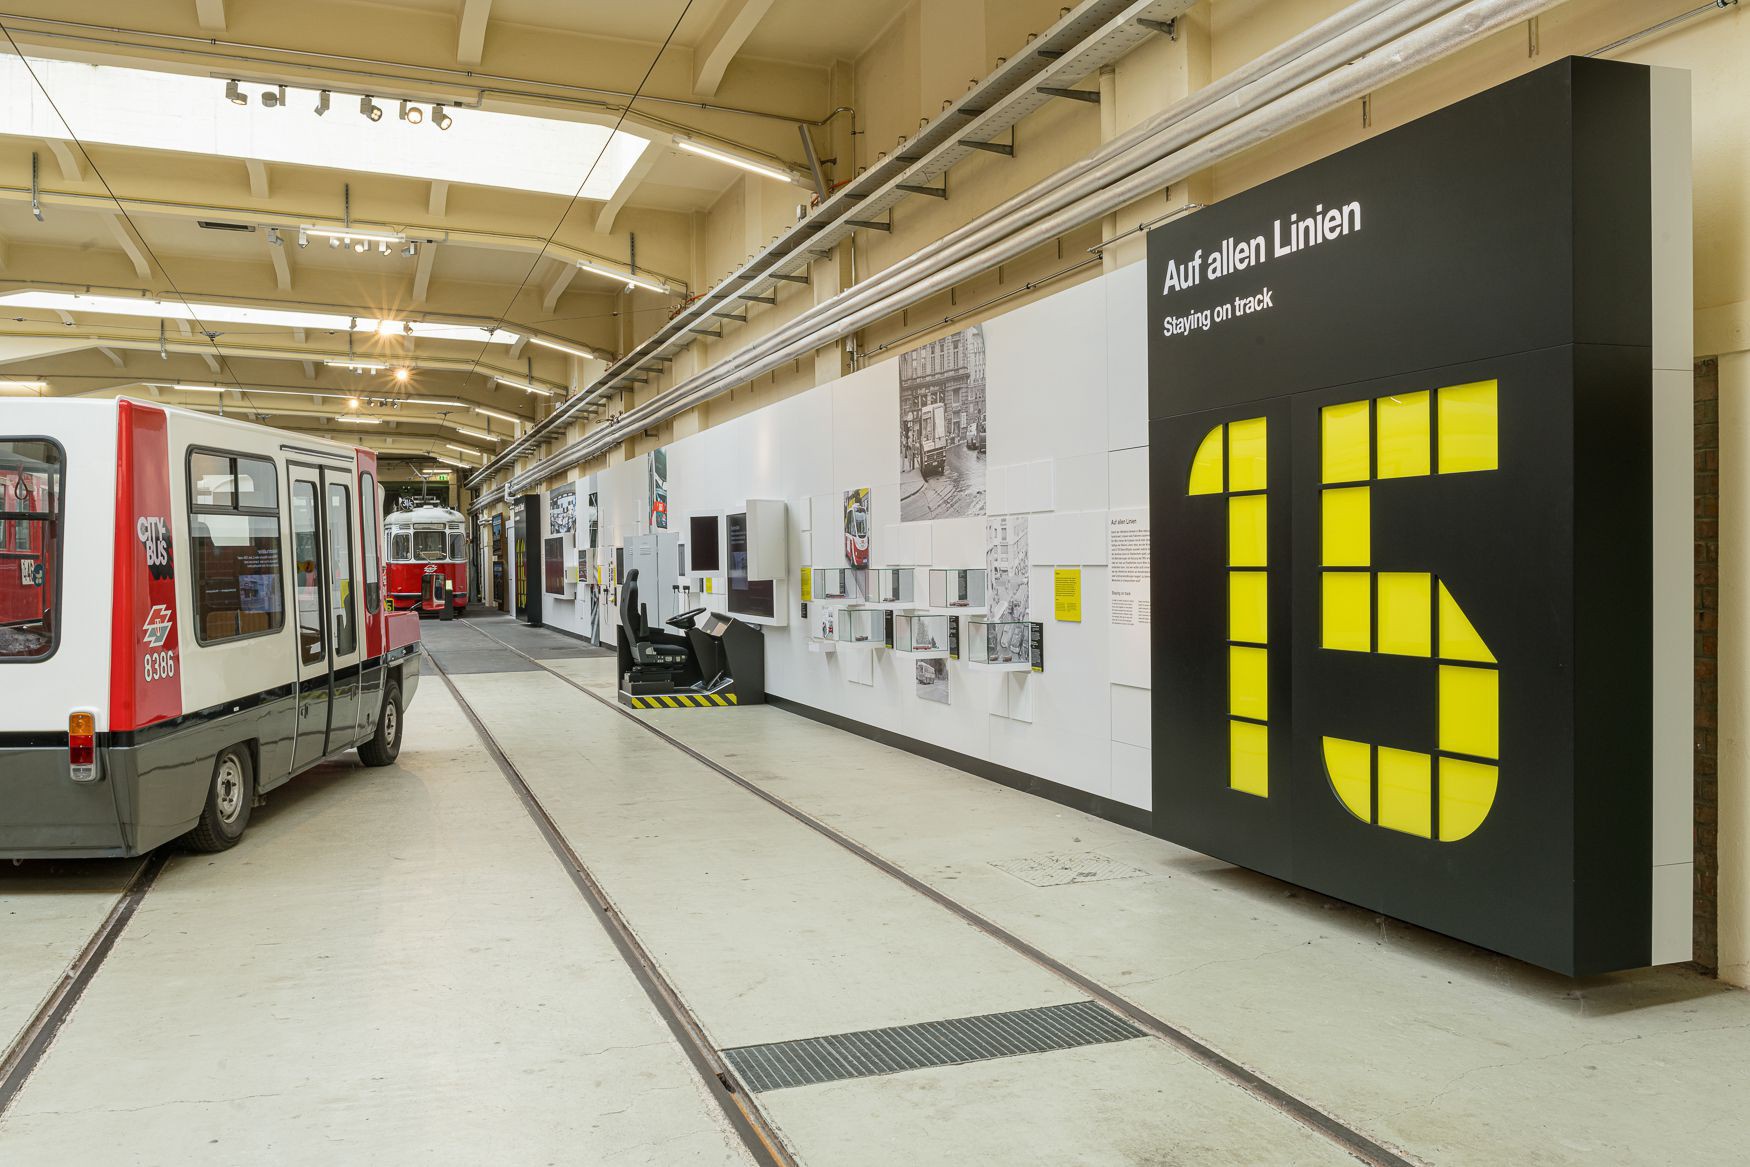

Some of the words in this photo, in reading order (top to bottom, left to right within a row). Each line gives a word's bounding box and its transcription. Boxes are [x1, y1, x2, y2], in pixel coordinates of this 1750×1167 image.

[1163, 249, 1202, 295] Auf
[1207, 235, 1265, 280] allen
[1274, 201, 1361, 258] Linien
[1163, 309, 1211, 336] Staying
[1214, 302, 1231, 322] on
[1234, 287, 1273, 316] track
[146, 540, 168, 566] BUS
[1187, 378, 1499, 843] 15
[144, 650, 175, 682] 8386
